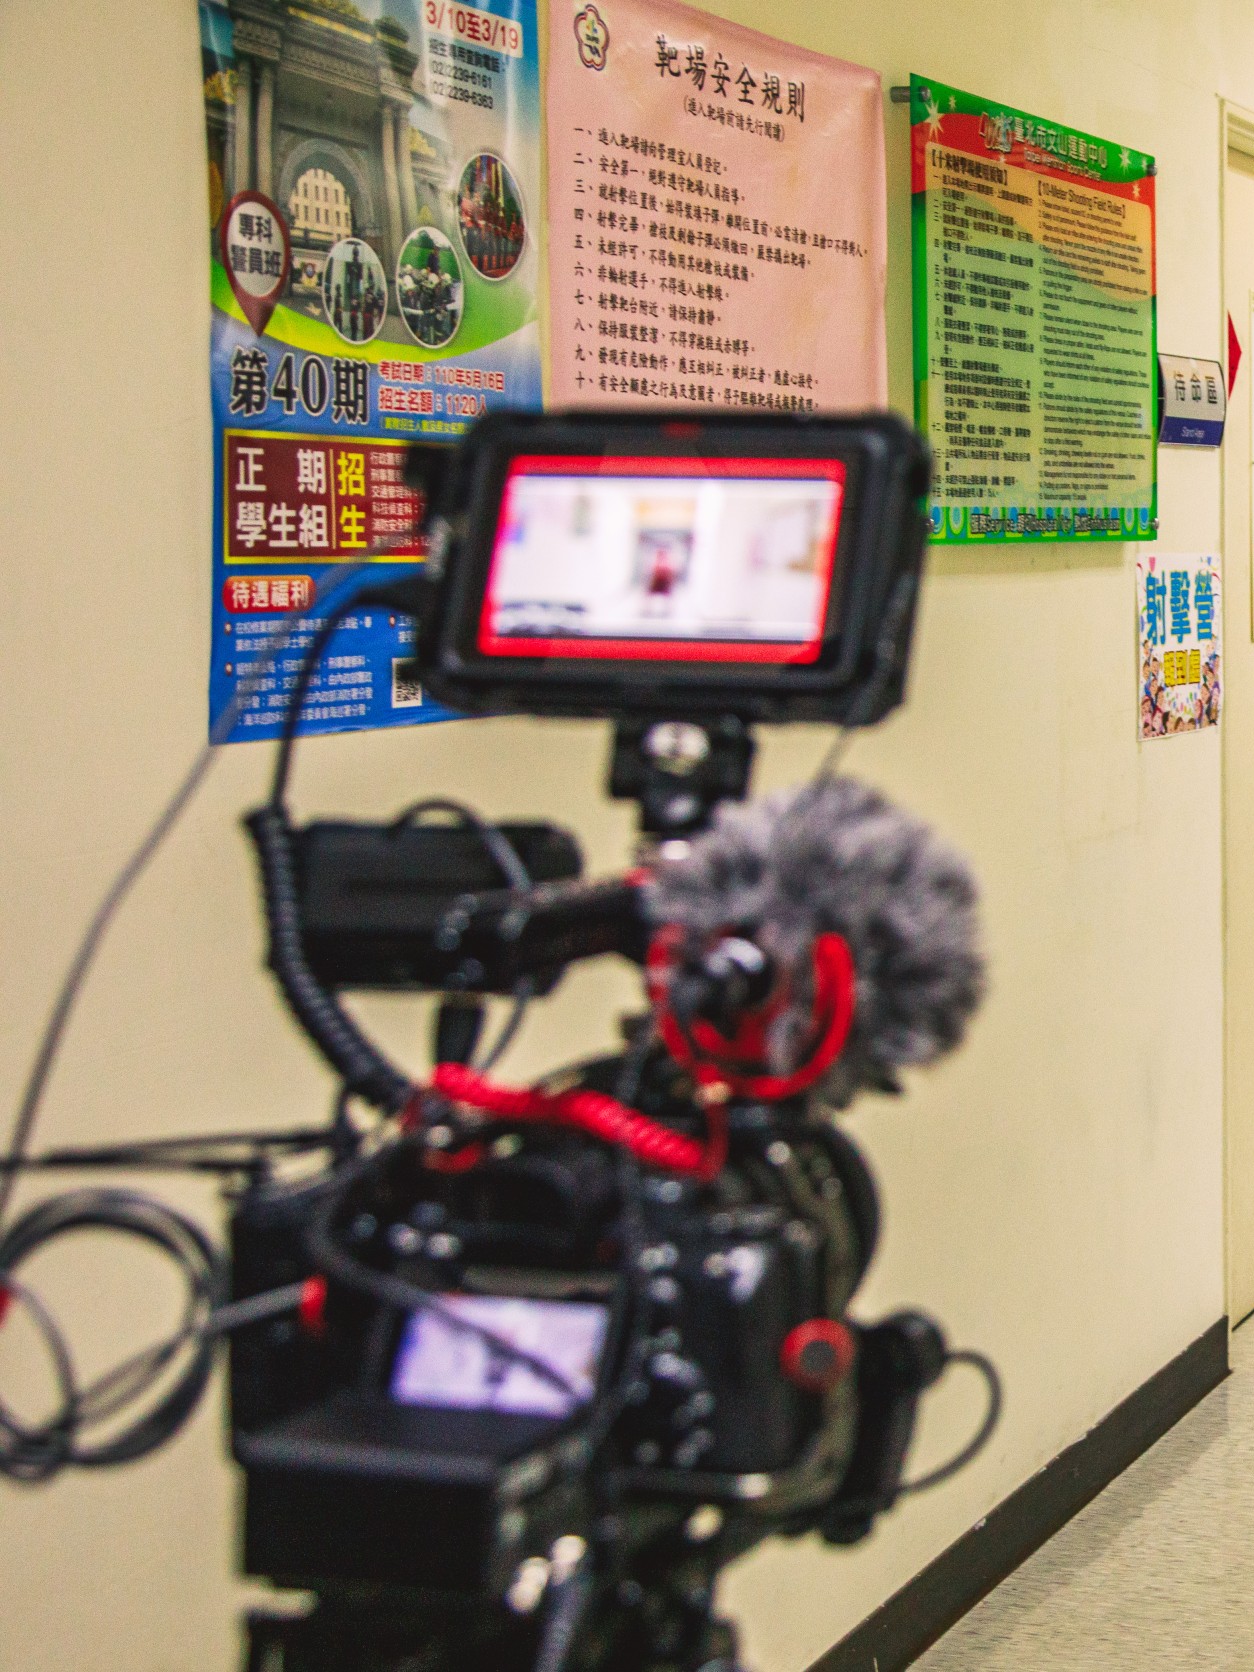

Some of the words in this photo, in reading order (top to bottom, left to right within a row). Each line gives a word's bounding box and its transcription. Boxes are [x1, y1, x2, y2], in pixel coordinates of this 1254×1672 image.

[654, 34, 806, 122] 靶場安全規則
[238, 212, 273, 245] 專科
[231, 244, 282, 279] 警員班
[229, 343, 370, 425] 第40期
[378, 387, 489, 417] 招生名額:1120人
[338, 452, 367, 548] 招生
[236, 502, 328, 549] 學生組
[231, 579, 309, 609] 待遇福利
[1146, 570, 1213, 645] 射擊營
